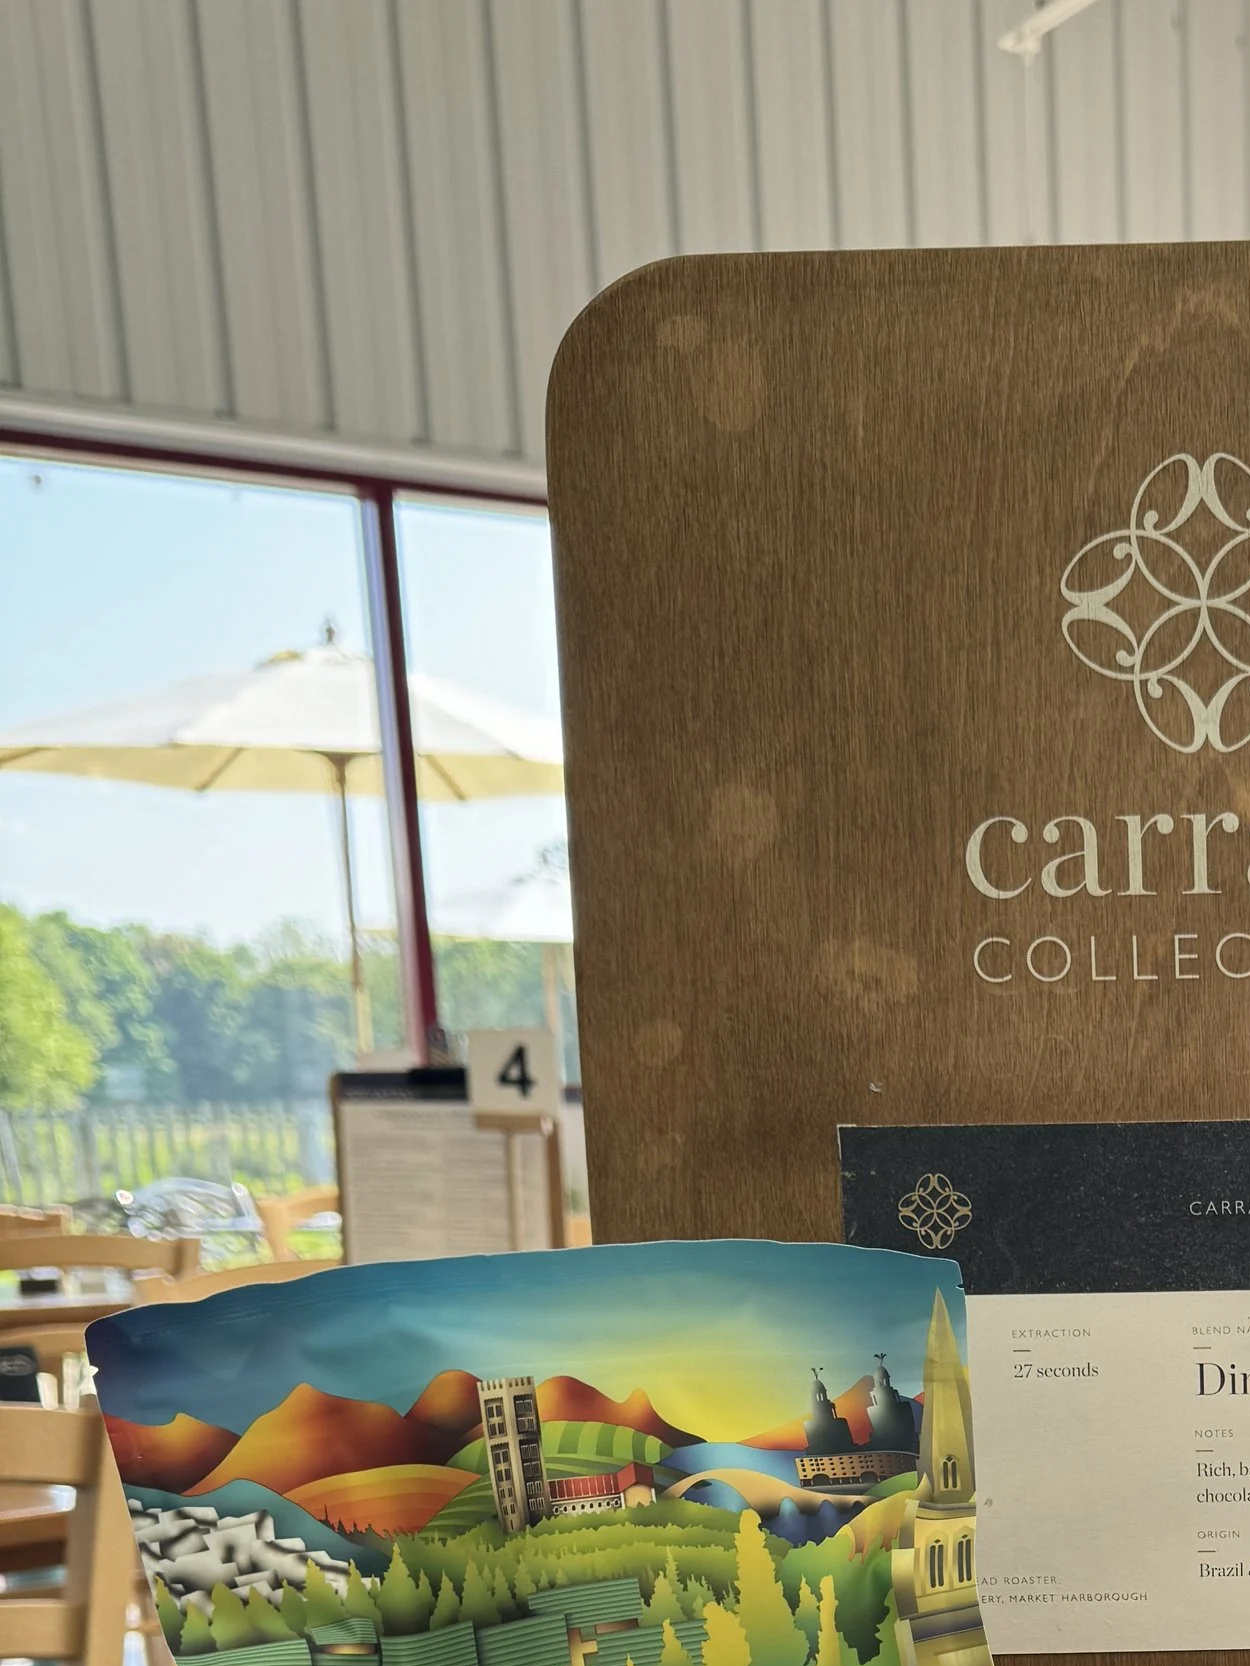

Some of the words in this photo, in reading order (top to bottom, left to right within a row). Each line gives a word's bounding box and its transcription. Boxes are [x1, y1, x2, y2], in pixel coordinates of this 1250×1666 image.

[498, 1044, 535, 1097] 4
[1012, 1328, 1091, 1339] EXTRACTION
[1192, 1325, 1232, 1336] BLEND
[1013, 1364, 1033, 1379] 27
[1036, 1362, 1099, 1379] seconds
[1194, 1428, 1235, 1439] NOTES
[1196, 1461, 1236, 1478] Rich,
[1197, 1530, 1241, 1540] ORIGIN
[1199, 1562, 1244, 1578] Brazil
[1009, 1593, 1055, 1603] MARKET
[1061, 1592, 1148, 1602] HARBOROUGH
